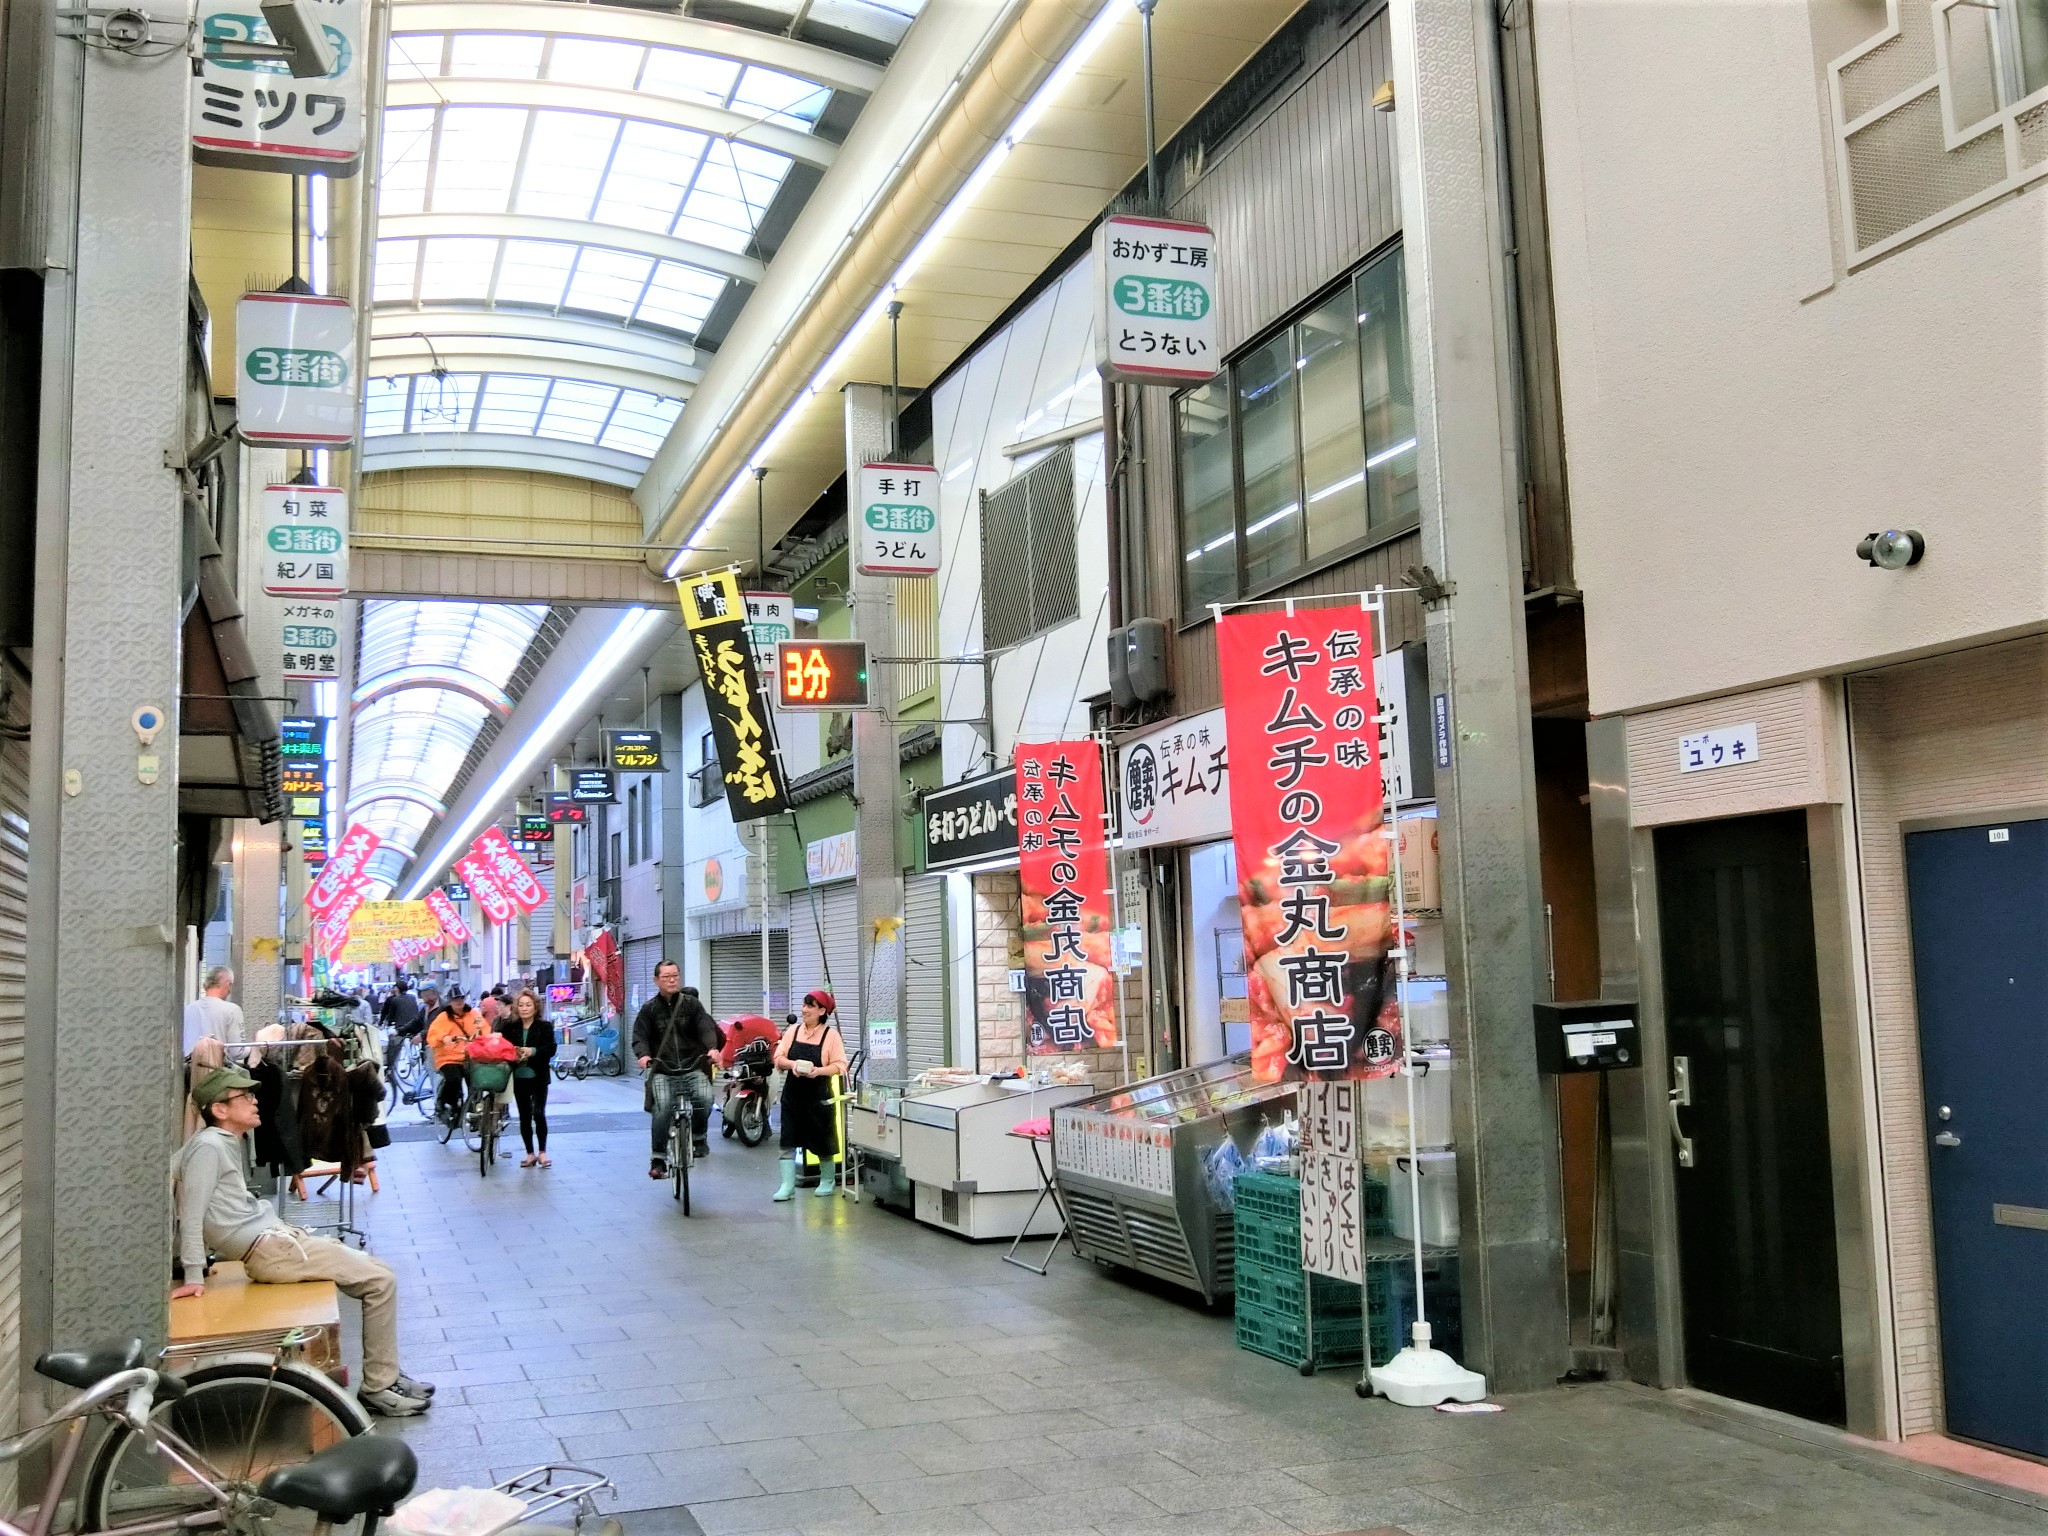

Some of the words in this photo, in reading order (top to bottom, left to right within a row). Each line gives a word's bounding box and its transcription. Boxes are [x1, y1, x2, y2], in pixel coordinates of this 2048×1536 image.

[202, 82, 346, 136] ミツワ
[1112, 237, 1208, 268] おかず工房
[1122, 278, 1203, 317] 3番街
[1119, 328, 1207, 356] とうない
[255, 351, 342, 384] 3番街
[878, 478, 921, 497] 手打
[282, 499, 328, 518] 旬菜
[872, 506, 931, 531] 3番街
[274, 527, 338, 551] 3番街
[875, 540, 927, 559] うどん
[277, 562, 334, 580] 紀ノ国
[283, 605, 335, 619] メガネの
[284, 627, 334, 647] 3番街
[283, 652, 335, 672] 高明堂
[1323, 629, 1371, 770] 伝承の味
[1159, 725, 1211, 761] 伝承の味
[1683, 733, 1710, 748] コーポ
[1689, 739, 1747, 767] ユウキ
[614, 753, 659, 766] マルフジ
[1161, 744, 1230, 805] キムチ
[1261, 629, 1355, 1070] キムチの金丸商店
[1992, 831, 2005, 840] 101
[482, 837, 541, 905] 大売出し
[463, 861, 510, 920] 大売出し
[1300, 1152, 1317, 1270] だいこん
[1320, 1155, 1337, 1272] きゅうり
[1338, 1160, 1359, 1276] はくさい
